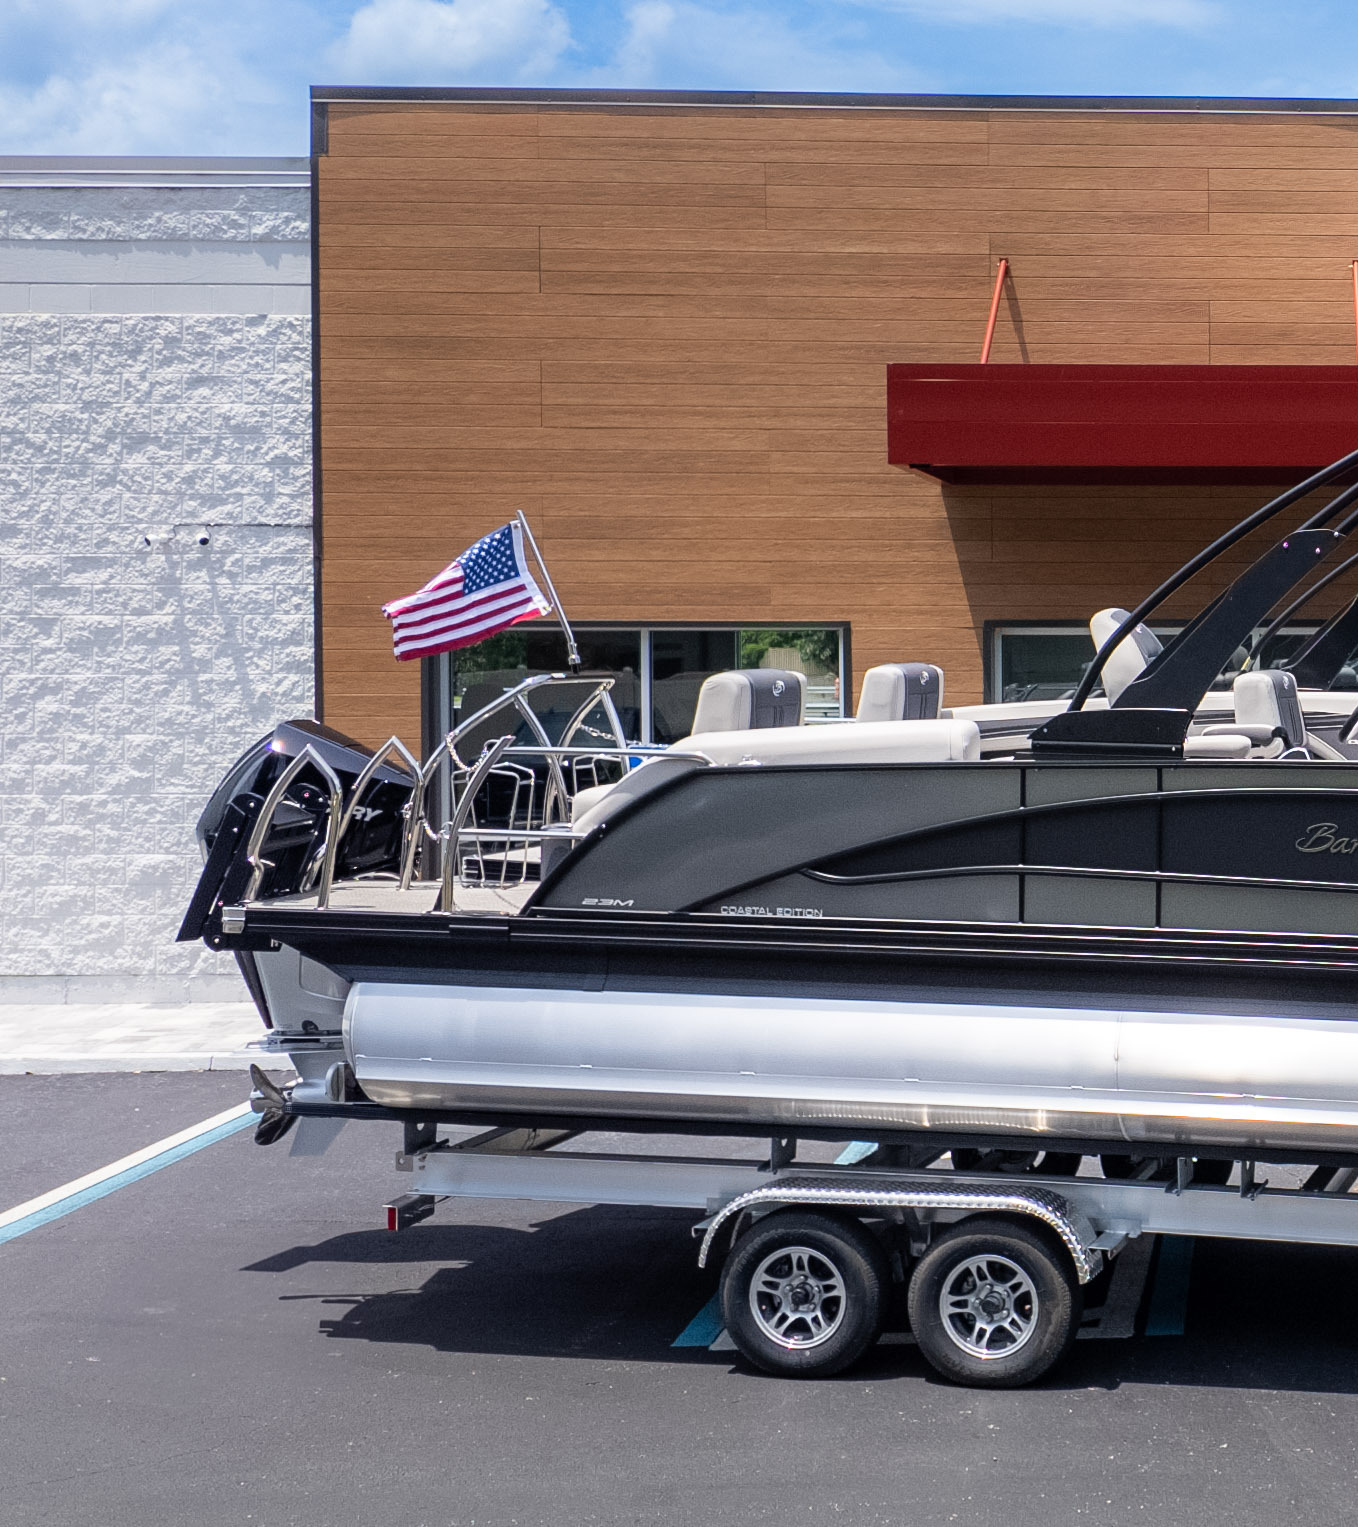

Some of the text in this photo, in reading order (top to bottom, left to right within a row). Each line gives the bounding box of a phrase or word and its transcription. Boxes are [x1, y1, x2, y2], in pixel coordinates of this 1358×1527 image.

[582, 897, 635, 907] 23M
[720, 906, 823, 918] COASTAL EDITION
